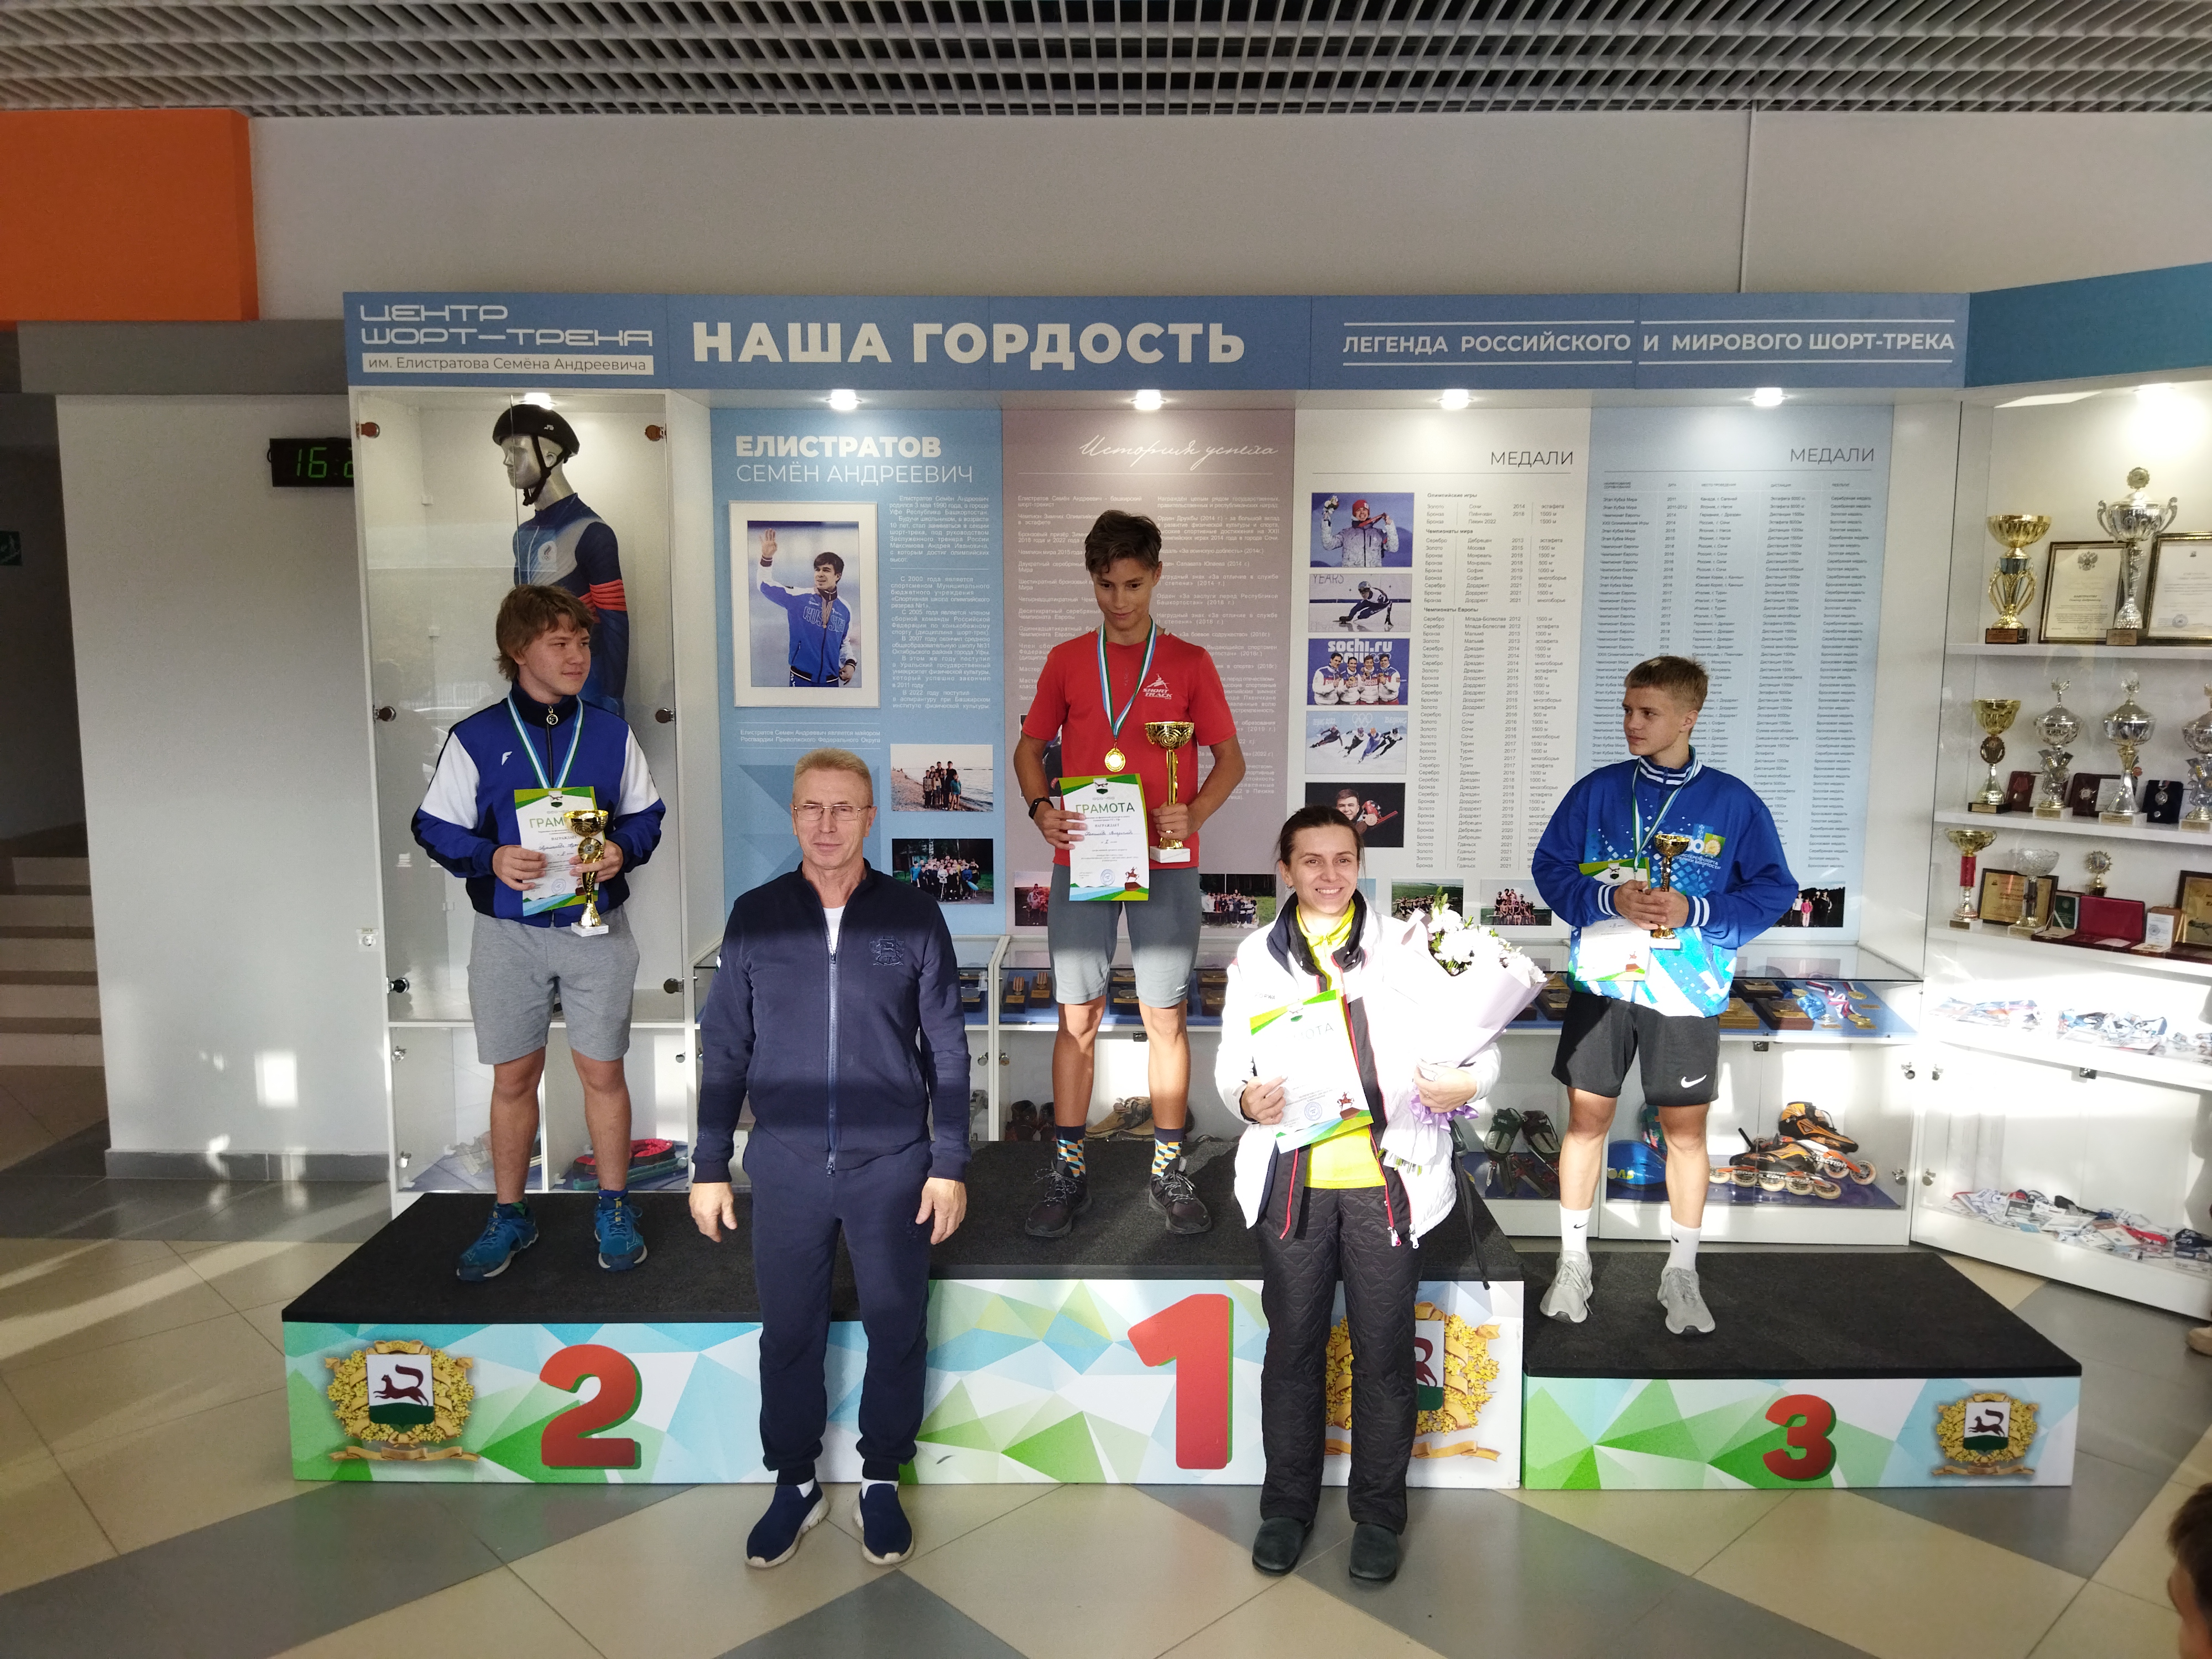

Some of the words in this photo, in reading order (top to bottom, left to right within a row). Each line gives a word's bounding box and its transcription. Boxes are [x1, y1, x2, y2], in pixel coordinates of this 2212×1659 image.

[360, 304, 508, 322] ЦЕНТР
[361, 327, 653, 347] ШОРТ-ТРЕКА
[693, 322, 892, 362] НАША
[914, 322, 1245, 371] ГОРДОСТЬ
[1343, 335, 1448, 356] ЛЕГЕНДА
[1460, 332, 1631, 353] РОССИЙСКОГО
[1642, 335, 1659, 352] И
[1672, 333, 1802, 351] МИРОВОГО
[1808, 332, 1954, 350] ШОРТ-ТРЕКА
[368, 359, 392, 368] им.
[397, 357, 489, 371] Елистратова
[494, 357, 549, 369] Семёна
[555, 358, 645, 373] Андреевича
[736, 436, 941, 458] ЕЛИСТРАТОВ
[1079, 434, 1200, 467] История
[1191, 442, 1279, 471] успеха
[1790, 447, 1875, 465] МЕДАЛИ
[1491, 451, 1573, 468] МЕДАЛИ
[737, 461, 819, 482] СЕМЁН
[827, 465, 973, 486] АНДРЕЕВИЧ
[1328, 638, 1392, 652] sochi.ru
[1076, 802, 1135, 814] ГРАМОТА
[529, 816, 565, 828] ГРАМ
[1128, 1293, 1230, 1469] 1
[539, 1344, 639, 1469] 2
[1763, 1394, 1835, 1481] 3
